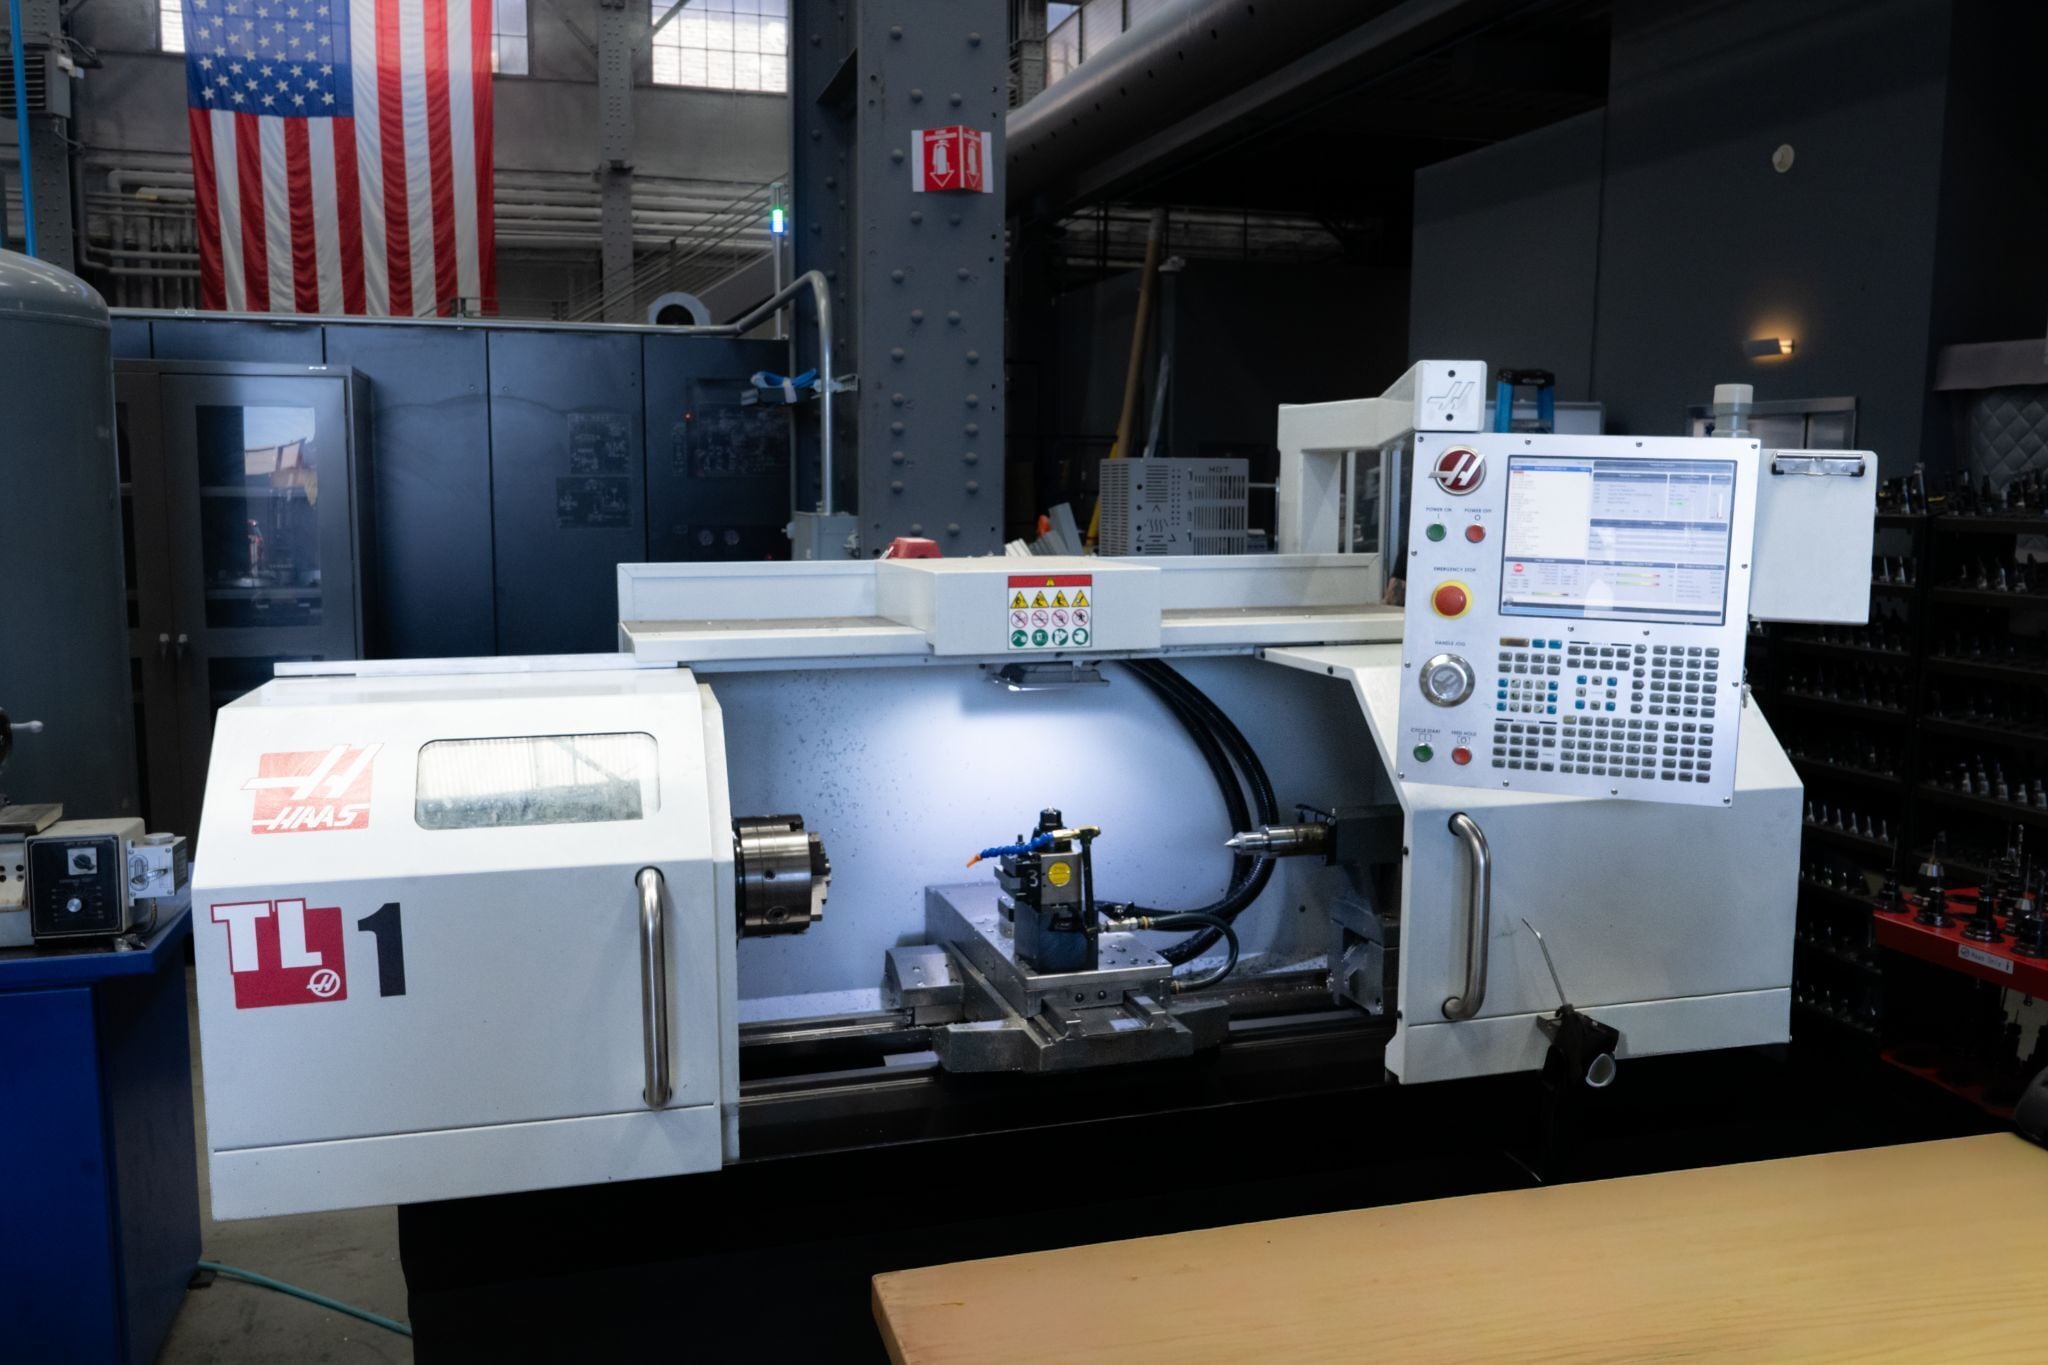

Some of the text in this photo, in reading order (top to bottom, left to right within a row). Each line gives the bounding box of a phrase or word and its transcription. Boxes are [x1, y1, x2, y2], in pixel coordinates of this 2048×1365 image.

[1209, 465, 1229, 473] HOT
[252, 803, 369, 831] HAAS
[1027, 869, 1039, 888] 3
[213, 900, 406, 997] TL 1
